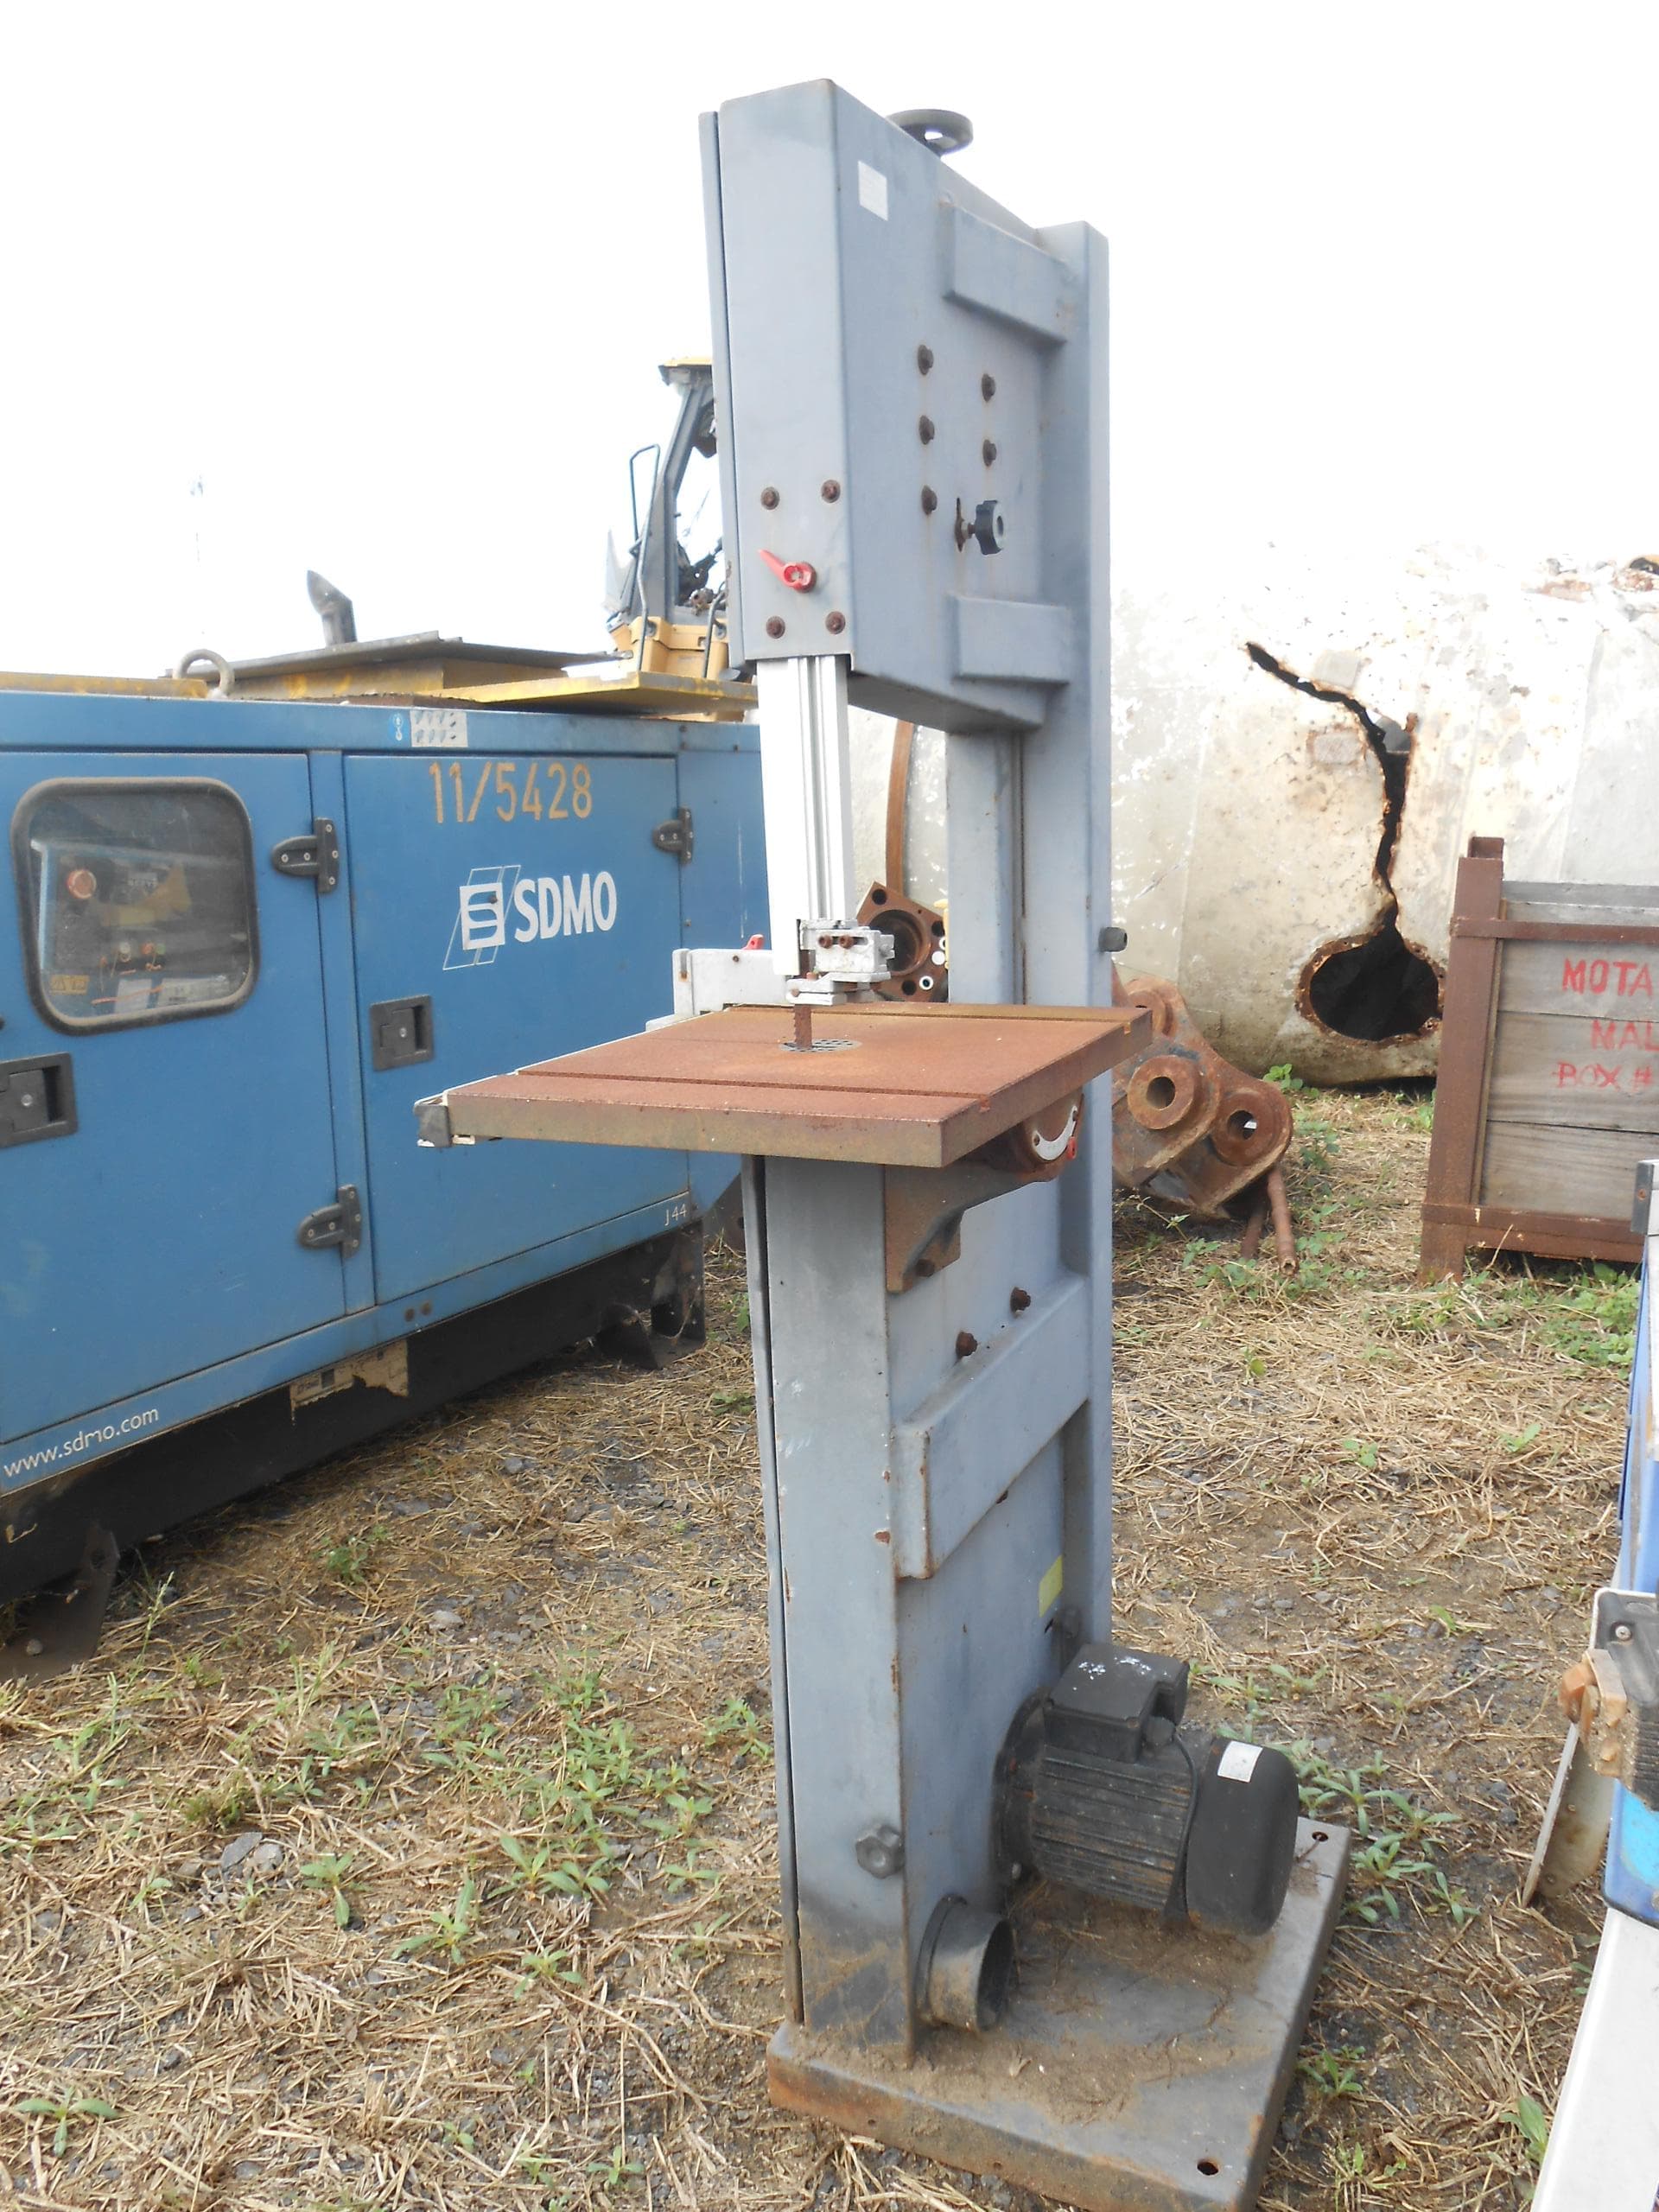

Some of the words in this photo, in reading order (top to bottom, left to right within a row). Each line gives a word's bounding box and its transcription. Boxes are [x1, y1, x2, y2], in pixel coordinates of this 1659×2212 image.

[429, 761, 592, 823] 11/5428
[513, 870, 617, 943] SDMO
[1562, 958, 1654, 996] MOTA
[664, 1203, 688, 1226] J44
[3, 1408, 159, 1478] www.sdmo.com
